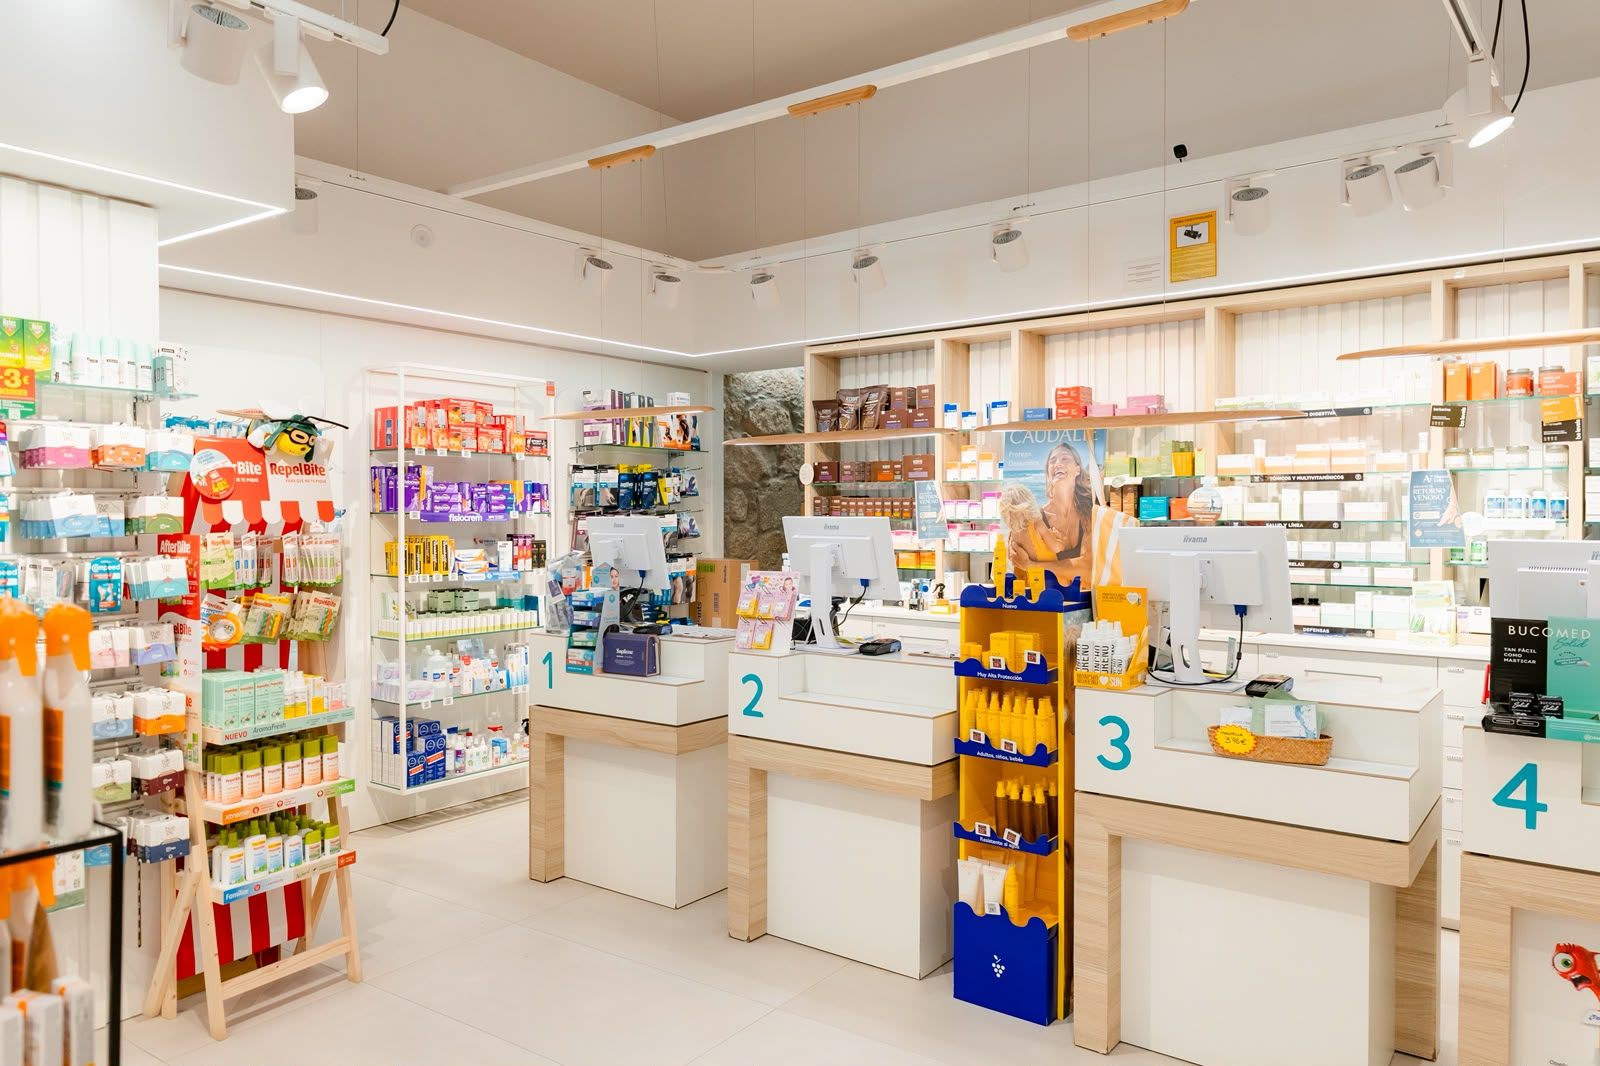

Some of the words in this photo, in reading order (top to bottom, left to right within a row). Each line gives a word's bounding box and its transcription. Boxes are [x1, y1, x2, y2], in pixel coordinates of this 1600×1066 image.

[269, 462, 326, 477] RepelBite
[449, 513, 483, 522] fisiocrem
[1183, 535, 1208, 543] iiyama
[160, 540, 191, 554] AfterBite
[1508, 625, 1591, 638] BUCOMED
[542, 651, 553, 689] 1
[977, 672, 987, 680] Muy
[998, 674, 1022, 682] Protección
[741, 673, 764, 718] 2
[224, 730, 248, 742] NUEVO
[253, 722, 287, 735] AromaFresh
[1096, 715, 1132, 771] 3
[1492, 763, 1548, 830] 4
